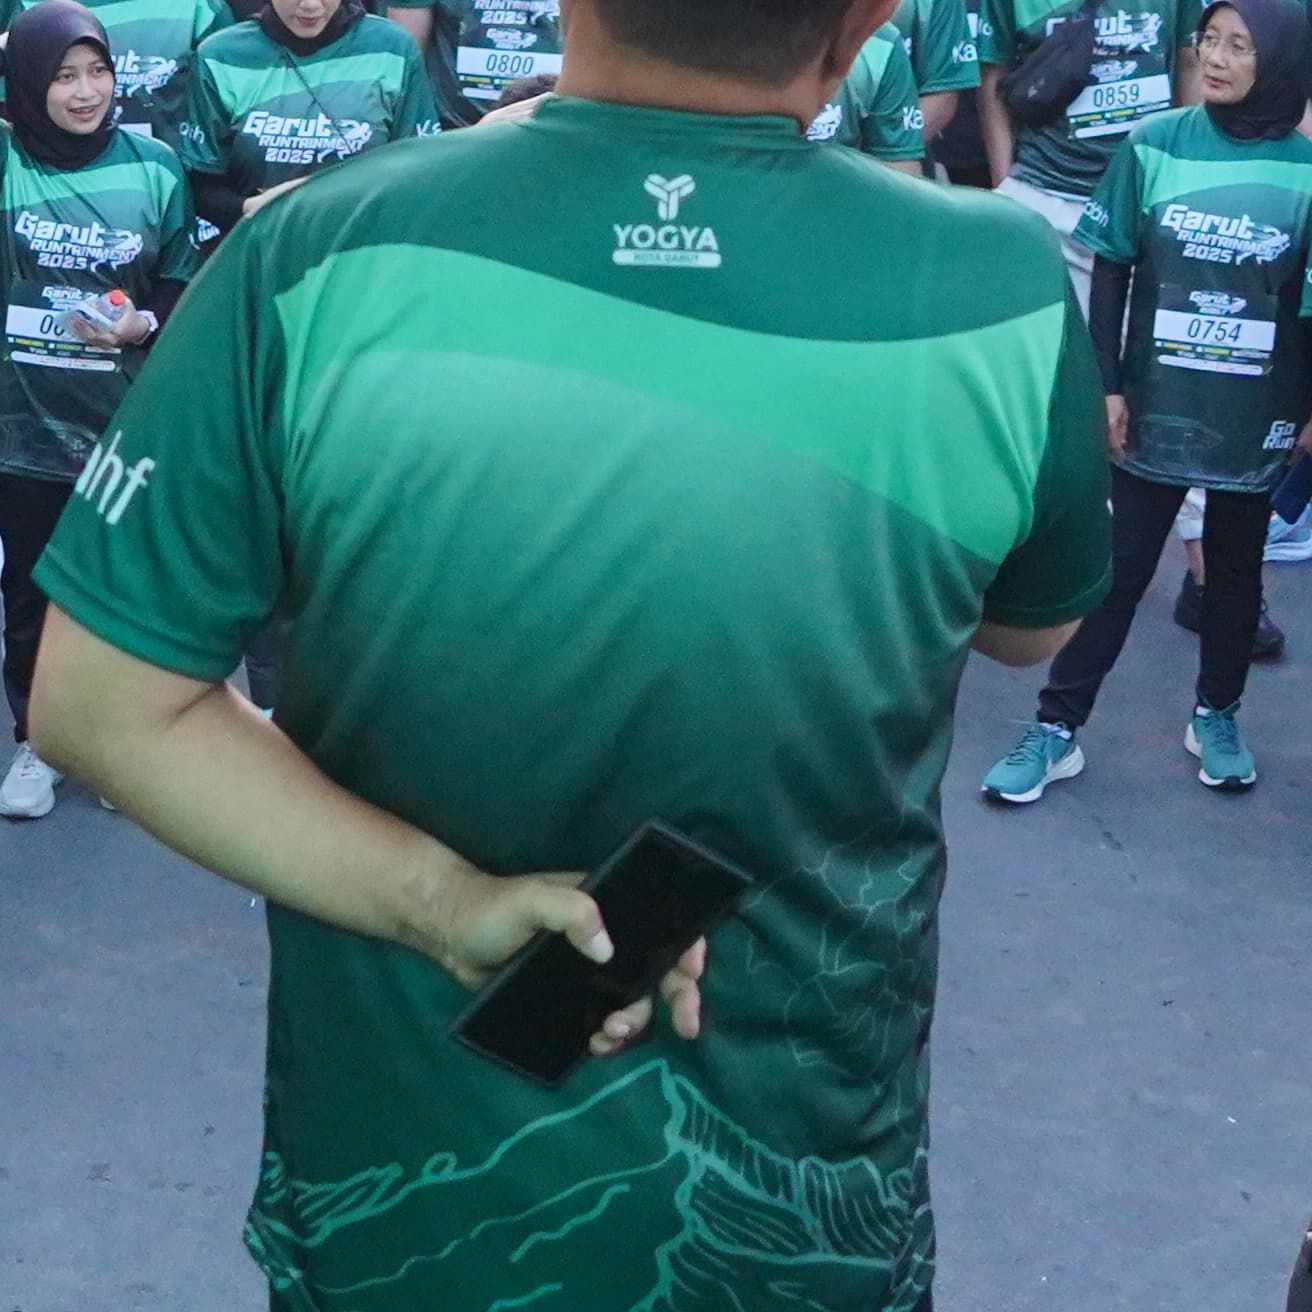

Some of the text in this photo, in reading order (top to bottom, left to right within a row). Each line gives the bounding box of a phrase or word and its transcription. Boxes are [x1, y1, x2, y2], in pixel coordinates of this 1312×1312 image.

[481, 10, 528, 25] 2025
[485, 53, 534, 75] 0800
[1093, 84, 1141, 108] 0859
[243, 110, 333, 138] Garut
[265, 146, 315, 164] 2025
[14, 209, 106, 248] Garut
[1160, 203, 1255, 238] Garut
[613, 223, 719, 251] YOGYA
[29, 240, 139, 263] RUNTAINMENT
[38, 252, 88, 270] 2025
[1182, 243, 1233, 264] 2025
[41, 284, 83, 300] Garut
[1188, 290, 1231, 307] Garut
[1186, 317, 1242, 344] 0754
[1269, 420, 1297, 438] Go
[1261, 435, 1297, 452] Run
